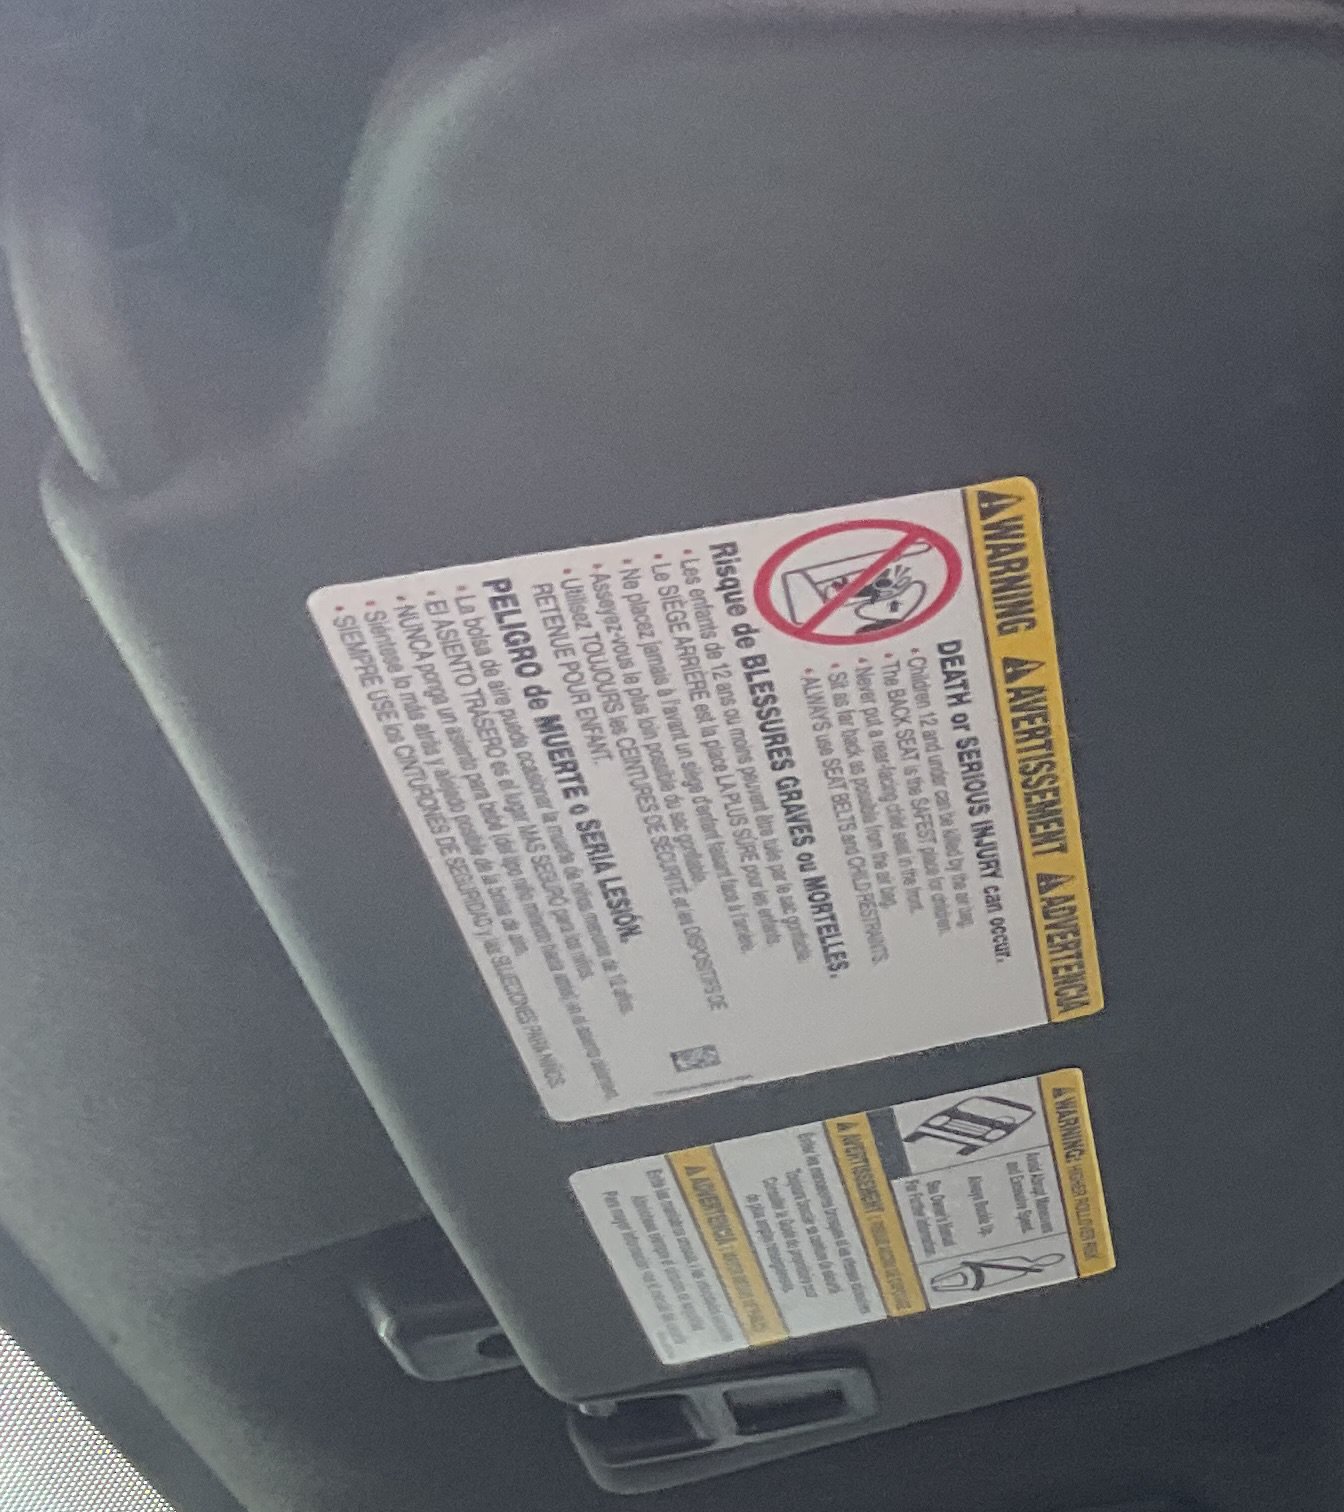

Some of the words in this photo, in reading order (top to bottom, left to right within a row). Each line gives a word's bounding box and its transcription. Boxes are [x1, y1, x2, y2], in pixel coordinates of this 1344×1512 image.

[616, 566, 644, 590] Ne
[649, 560, 679, 582] Le
[677, 556, 707, 586] Les
[701, 539, 756, 619] Risque
[977, 515, 1039, 636] WARNING
[422, 598, 451, 616] El
[452, 593, 481, 615] La
[528, 581, 576, 659] RETENUE
[557, 576, 598, 632] Utilisez
[582, 571, 639, 671] Asseyez-vous
[620, 591, 660, 640] placez
[656, 582, 696, 634] SIÈGE
[686, 586, 722, 640] enfants
[391, 603, 436, 661] NUNCA
[460, 615, 498, 657] bolsa
[478, 576, 546, 681] PELIGRO
[729, 619, 764, 651] de
[329, 613, 386, 689] SIEMPRE
[361, 608, 410, 674] Siéntese
[389, 674, 417, 690] lo
[430, 616, 480, 688] ASIENTO
[477, 657, 505, 678] de
[636, 639, 674, 687] jamais
[671, 632, 716, 702] ARRIÈRE
[701, 640, 728, 661] de
[411, 662, 453, 706] ponga
[556, 659, 593, 705] POUR
[577, 631, 626, 715] TOUJOURS
[620, 670, 644, 685] le
[707, 660, 734, 681] 12
[825, 669, 849, 690] Sit
[852, 665, 880, 705] Never
[879, 660, 905, 687] The
[904, 655, 935, 709] Children
[935, 638, 973, 707] DEATH
[362, 688, 400, 722] USE
[485, 677, 517, 707] aire
[519, 681, 557, 711] de
[621, 685, 654, 716] plus
[655, 686, 678, 698] à
[713, 681, 738, 707] ans
[798, 674, 832, 732] ALWAYS
[830, 691, 851, 708] as
[885, 687, 913, 728] BACK
[434, 706, 461, 726] un
[458, 687, 508, 760] TRASERO
[493, 706, 533, 750] puede
[605, 714, 633, 736] les
[635, 715, 662, 741] loin
[659, 698, 691, 741] l'avant
[692, 701, 720, 724] est
[698, 723, 724, 738] la
[721, 707, 743, 725] ou
[738, 652, 797, 772] BLESSURES
[834, 708, 858, 729] far
[858, 704, 885, 729] put
[916, 711, 938, 728] 12
[948, 711, 971, 734] or
[378, 722, 410, 745] los
[573, 706, 614, 766] ENFANT.
[672, 741, 693, 760] un
[726, 725, 757, 765] moins
[813, 732, 836, 757] use
[839, 727, 865, 758] back
[866, 728, 884, 738] a
[893, 727, 920, 762] SEAT
[919, 727, 943, 754] and
[488, 759, 515, 778] es
[531, 713, 590, 801] MUERTE
[613, 734, 659, 813] CEINTURES
[699, 737, 734, 775] place
[846, 759, 866, 776] as
[865, 739, 902, 803] rear-facing
[901, 762, 923, 776] is
[924, 754, 950, 790] under
[1004, 681, 1071, 859] AVERTISSEMENT
[387, 742, 450, 835] CINTURONES
[496, 777, 521, 791] el
[713, 772, 741, 793] LA
[819, 756, 848, 794] SEAT
[904, 775, 927, 797] the
[953, 735, 992, 818] SERIOUS
[567, 801, 593, 817] o
[720, 791, 750, 828] PLUS
[771, 772, 817, 848] GRAVES
[828, 791, 857, 833] BELTS
[931, 788, 955, 812] can
[640, 813, 666, 835] DE
[908, 795, 938, 847] SAFEST
[429, 835, 460, 857] DE
[573, 817, 620, 875] SERIA
[730, 825, 764, 864] SÛRE
[794, 850, 819, 873] ou
[838, 830, 863, 857] and
[969, 818, 1003, 882] INJURY
[844, 854, 871, 892] CHILD
[595, 873, 652, 945] LESIÓN.
[982, 883, 1004, 914] can
[801, 874, 853, 979] MORTELLES.
[988, 915, 1013, 963] occur.
[1038, 890, 1093, 1014] ADVERTENCIA
[1054, 1096, 1086, 1163] WARNING:
